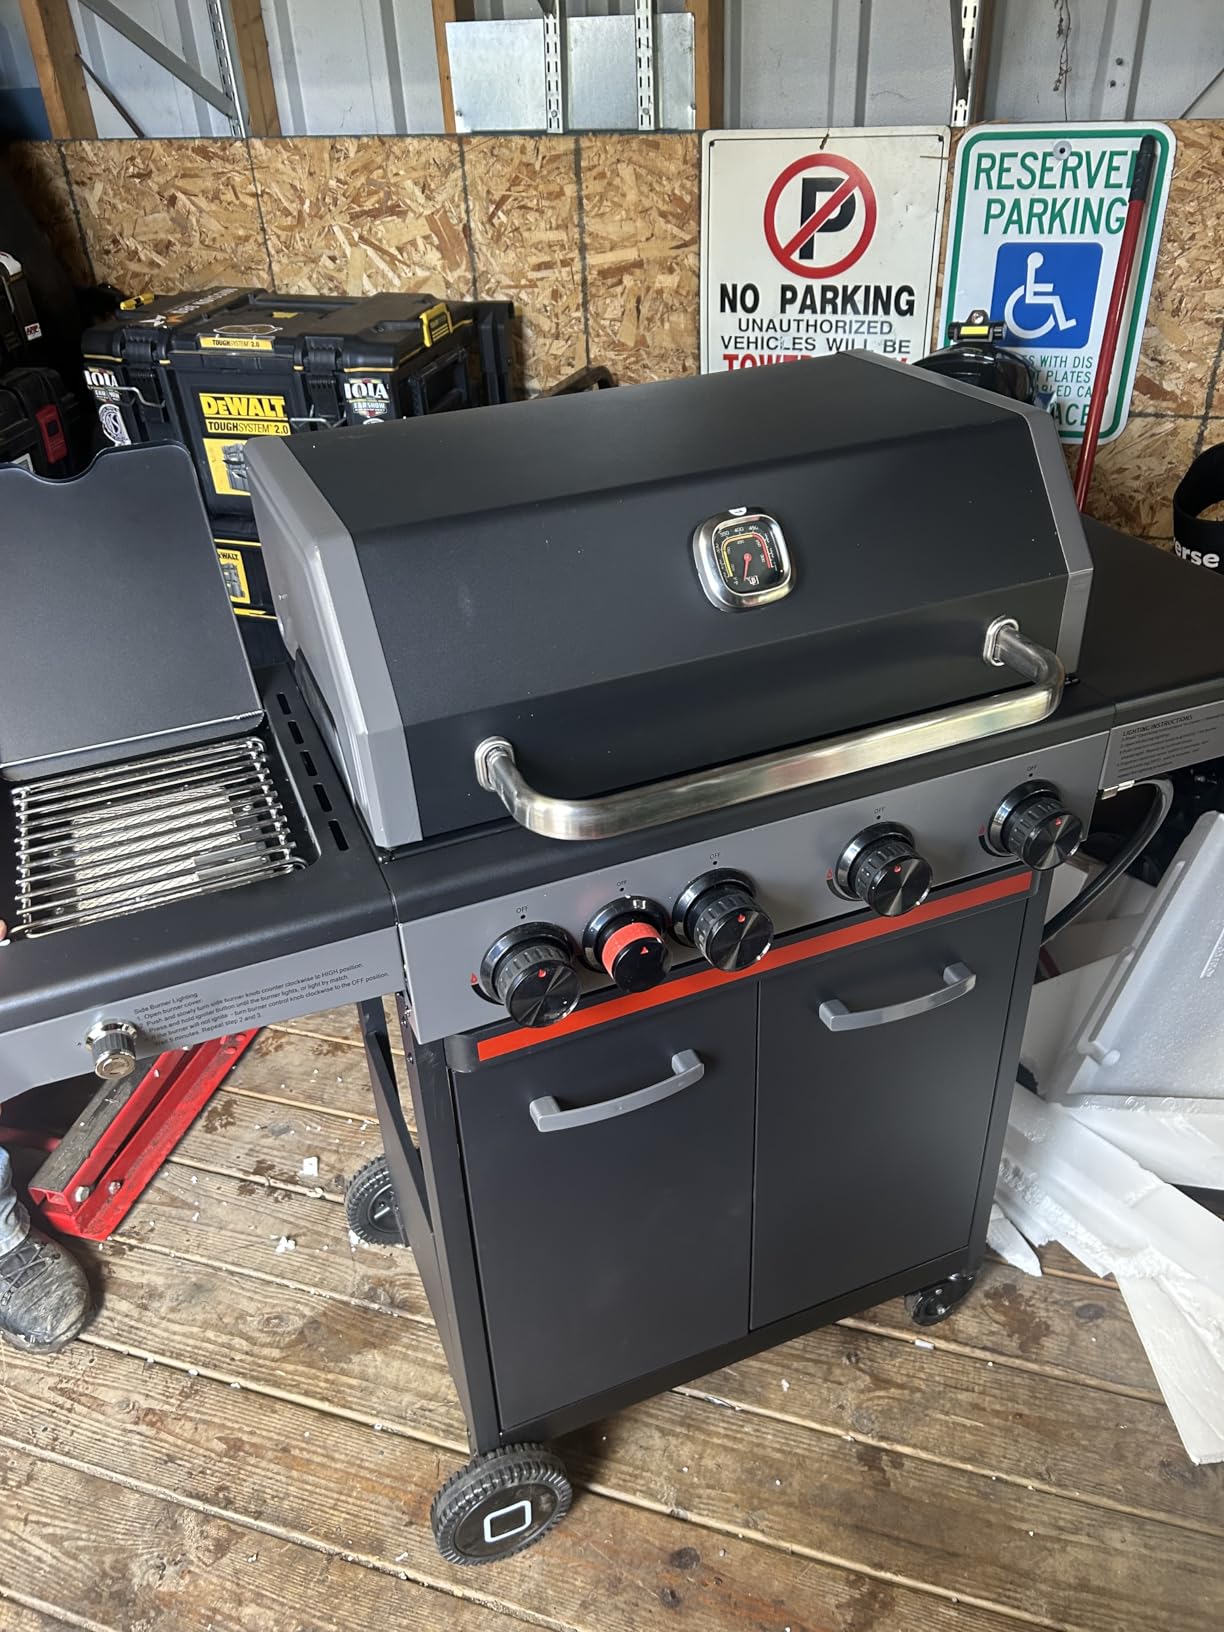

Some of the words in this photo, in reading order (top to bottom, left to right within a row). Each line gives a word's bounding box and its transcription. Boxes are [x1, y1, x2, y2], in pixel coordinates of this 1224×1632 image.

[983, 196, 1127, 235] PARKING
[720, 283, 760, 314] NO
[780, 284, 915, 317] PARKING
[738, 318, 893, 335] UNAUTHORIZED
[721, 336, 816, 351] VEHICLES
[826, 337, 872, 352] WILL
[883, 339, 911, 354] BE
[1040, 355, 1067, 368] WITH
[1072, 356, 1093, 368] DIS
[1046, 370, 1091, 383] PLATES
[208, 421, 271, 433] TOUGHSYSTEM
[274, 424, 289, 434] 2.0
[1174, 538, 1220, 568] erse
[1123, 726, 1150, 736] LIGHTING
[516, 905, 528, 914] OFF
[146, 1018, 162, 1026] Push
[176, 1008, 195, 1017] slowly
[261, 984, 283, 993] counter
[284, 976, 313, 987] clockwise
[321, 969, 338, 977] HIGH
[260, 993, 280, 1001] burner
[307, 982, 320, 990] light
[268, 998, 288, 1007] control
[289, 994, 304, 1002] knob
[305, 987, 333, 997] clockwise
[149, 1001, 170, 1009] Burner
[172, 993, 198, 1004] Lighting
[144, 1011, 161, 1020] Open
[162, 1005, 182, 1013] burner
[201, 1023, 223, 1033] Repeat
[224, 1019, 238, 1027] step
